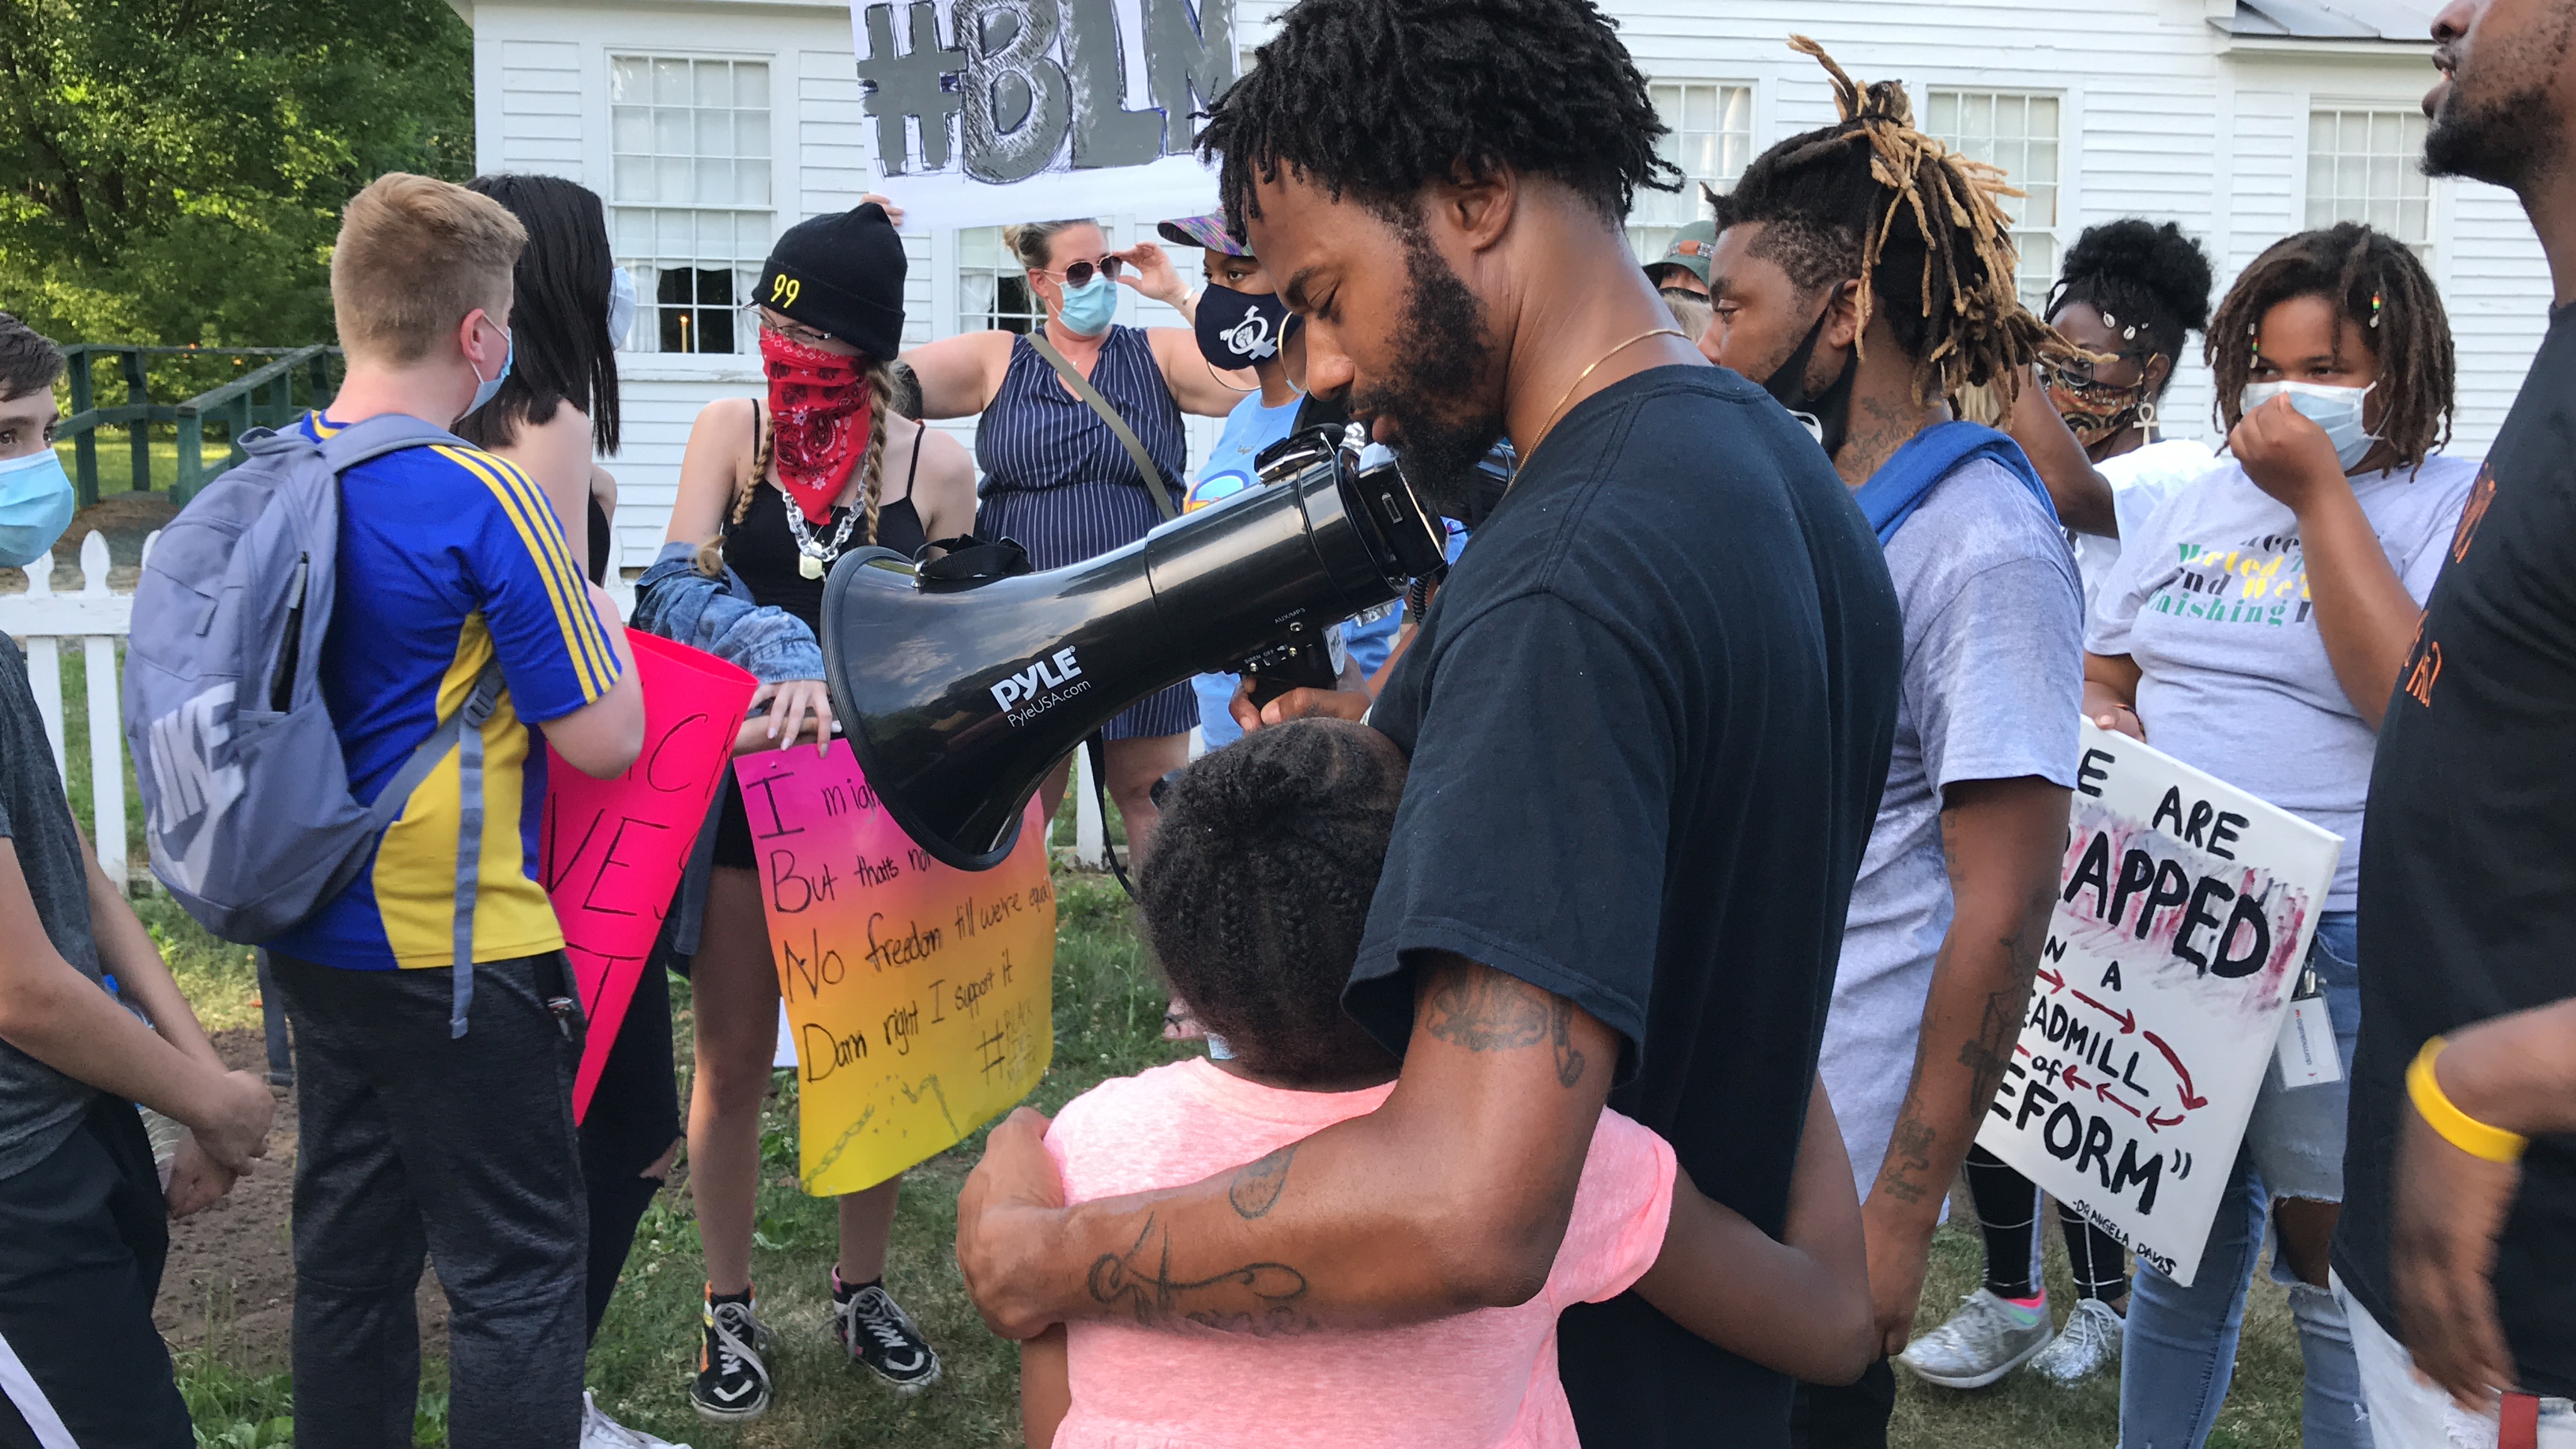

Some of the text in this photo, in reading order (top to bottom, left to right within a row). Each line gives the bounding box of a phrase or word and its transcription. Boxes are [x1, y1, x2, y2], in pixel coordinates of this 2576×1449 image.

[770, 274, 800, 308] 99
[1274, 607, 1306, 624] AUX/MP3
[990, 648, 1082, 713] PYLE
[1008, 680, 1091, 727] PyleUSA.com
[746, 772, 805, 840] I
[2152, 785, 2250, 860] ARE
[770, 849, 838, 913] But
[2059, 826, 2271, 979] APPED
[784, 927, 845, 1004] No
[954, 896, 975, 940] till
[2101, 960, 2121, 991] A
[883, 1000, 918, 1055] right
[929, 979, 945, 1024] I
[1001, 948, 1013, 988] it
[2023, 989, 2150, 1097] ADMILL
[2031, 1055, 2063, 1085] of
[2090, 1209, 2129, 1246] ANGELA
[2136, 1242, 2177, 1275] DAVIS
